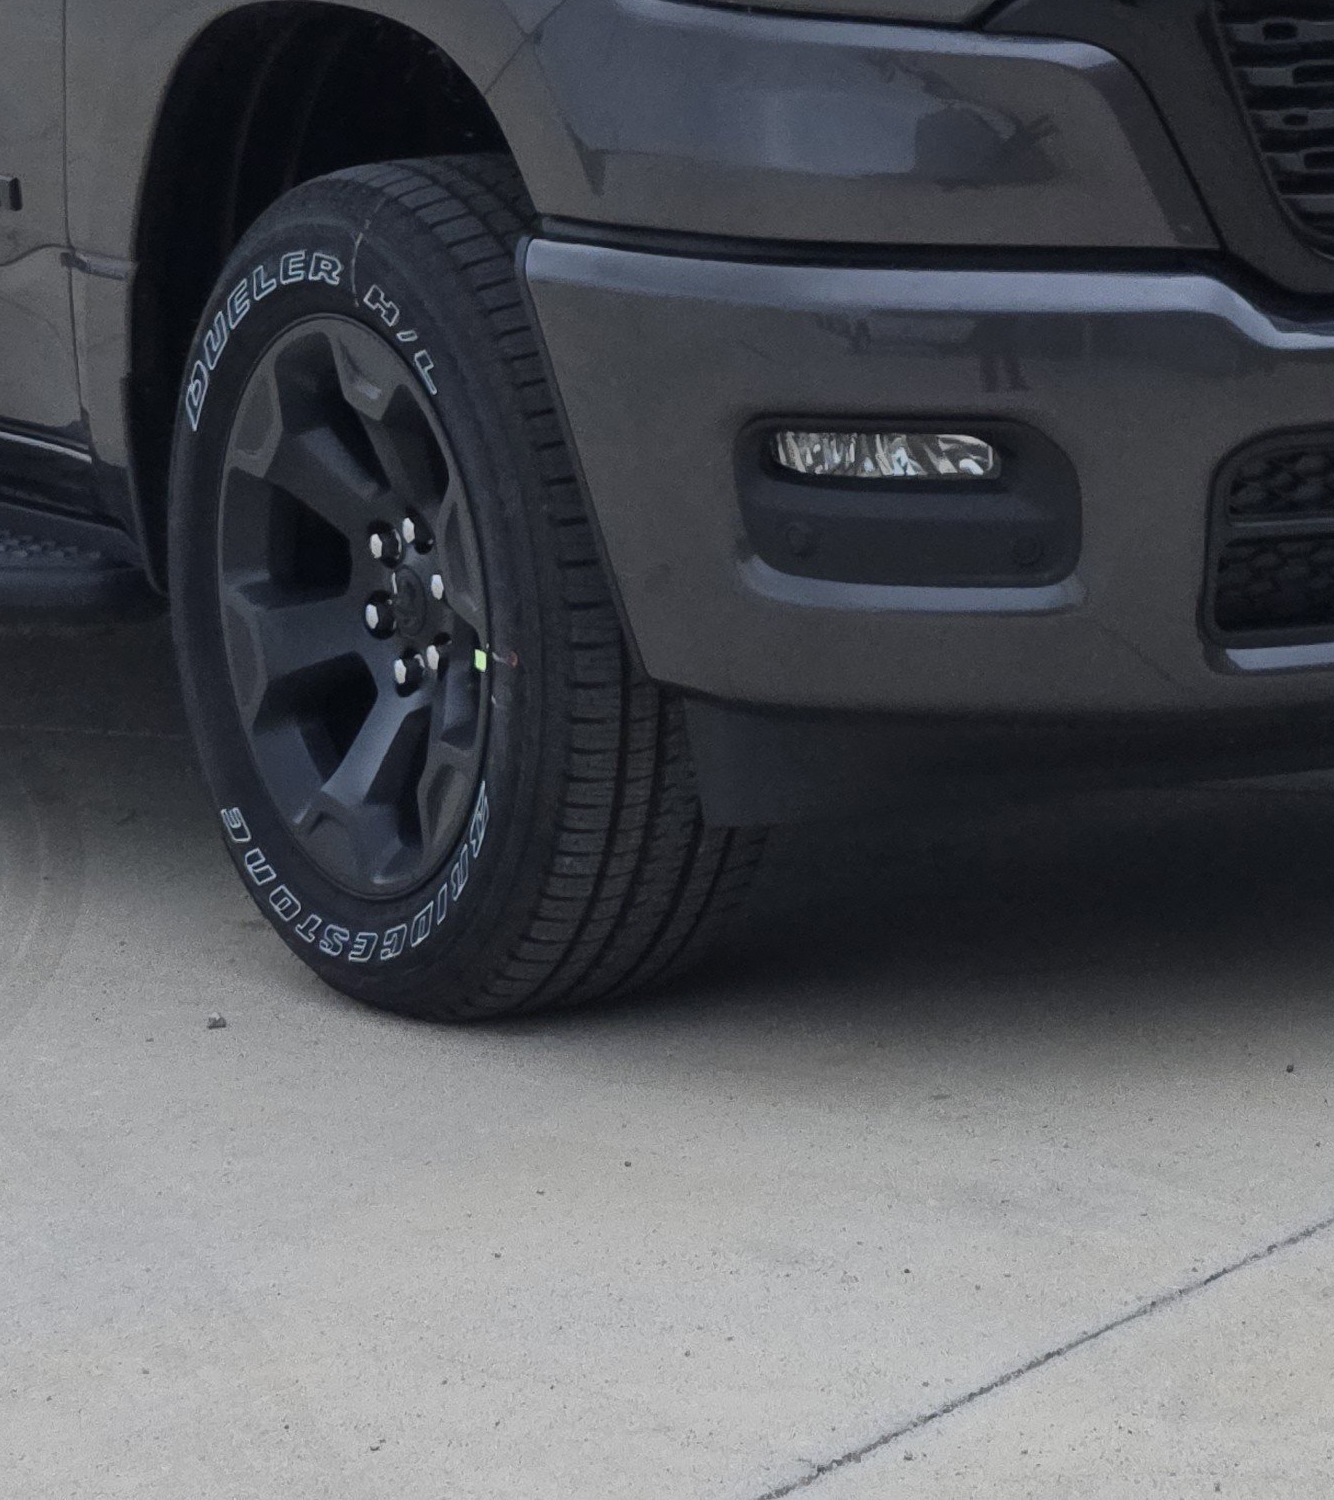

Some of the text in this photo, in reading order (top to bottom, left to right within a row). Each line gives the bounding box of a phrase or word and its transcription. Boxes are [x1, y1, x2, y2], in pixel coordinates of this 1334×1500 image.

[185, 250, 438, 432] DUELER H/L
[220, 779, 490, 963] BRIDGESTONE
